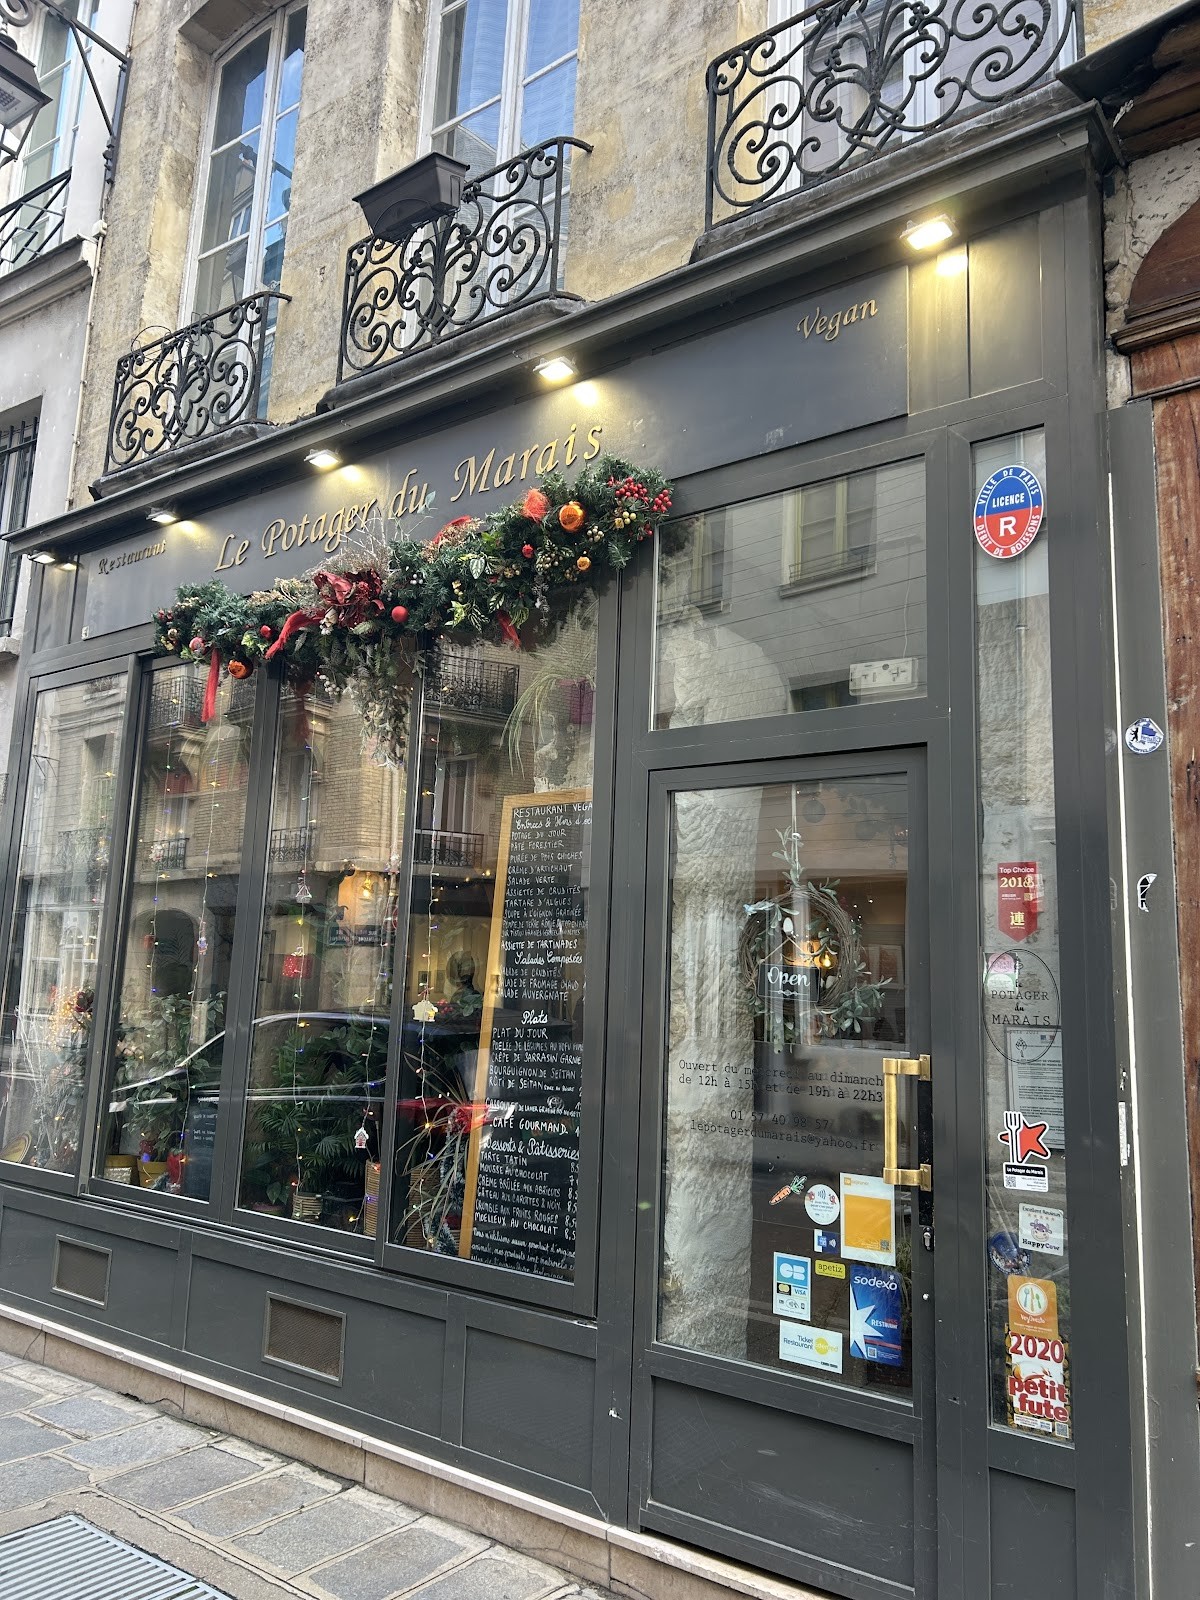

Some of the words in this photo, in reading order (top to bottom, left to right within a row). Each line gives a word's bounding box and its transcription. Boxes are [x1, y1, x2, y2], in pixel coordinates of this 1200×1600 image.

[797, 299, 879, 341] Vegan
[978, 477, 998, 506] VILLE
[1002, 468, 1014, 478] DE
[1018, 470, 1040, 496] PARIS
[214, 533, 251, 573] Le
[261, 498, 378, 559] Potager
[388, 468, 433, 520] du
[450, 423, 603, 503] Marais
[992, 492, 1025, 509] LICENCE
[999, 515, 1018, 537] R
[976, 523, 993, 548] DEBIT
[993, 546, 1005, 557] DE
[1009, 514, 1041, 555] BOISSONS
[98, 539, 167, 575] Restaurant
[513, 804, 570, 819] RESTAURANT
[572, 801, 592, 812] VEGA
[545, 817, 552, 828] &
[511, 831, 532, 841] POTAGE
[548, 828, 567, 839] JOUR
[528, 840, 565, 850] FORESTIER
[541, 852, 554, 862] POIS
[556, 851, 583, 860] CHICHES
[1000, 866, 1012, 875] Top
[507, 876, 530, 886] SALADE
[535, 876, 555, 884] VERTE
[506, 888, 534, 897] ASSIETTE
[505, 899, 535, 908] TARTARE
[501, 940, 526, 950] ASSIETTE
[527, 941, 535, 949] DE
[537, 939, 578, 949] TARTINADES
[514, 951, 545, 965] Salades
[546, 949, 583, 968] Composées
[521, 968, 528, 976] DE
[767, 965, 811, 987] Open
[519, 978, 527, 988] DE
[530, 978, 558, 990] FROMAGE
[521, 989, 569, 1001] AUVERGNATE
[990, 990, 1050, 1001] POTAGER
[1014, 1001, 1025, 1012] du
[521, 1010, 549, 1025] Plats
[991, 1013, 1052, 1026] MARAIS
[492, 1027, 512, 1038] PLAT
[514, 1027, 525, 1038] DU
[527, 1028, 549, 1039] JOUR
[514, 1041, 521, 1050] DE
[513, 1053, 521, 1063] DE
[524, 1052, 559, 1064] SARRASIN
[489, 1065, 539, 1078] BOURGUIGNON
[540, 1069, 547, 1078] DE
[679, 1059, 718, 1075] Ouvert
[724, 1062, 738, 1075] du
[808, 1072, 822, 1082] au
[830, 1071, 884, 1088] dimanch
[507, 1079, 516, 1089] DE
[679, 1074, 692, 1085] de
[698, 1076, 718, 1088] 12h
[724, 1076, 731, 1089] à
[738, 1078, 756, 1091] 15h
[765, 1082, 779, 1093] et
[786, 1083, 800, 1095] de
[808, 1085, 831, 1098] 19h
[838, 1086, 845, 1099] à
[853, 1088, 883, 1103] 22h3
[492, 1116, 515, 1129] CAFÉ
[519, 1118, 569, 1136] GOURMAND
[730, 1109, 743, 1121] 01
[751, 1111, 764, 1123] 57
[772, 1113, 786, 1125] 40
[793, 1116, 807, 1128] 98
[815, 1117, 829, 1130] 57
[690, 1118, 876, 1151] lepotagerdumarais@yahoo.fr
[518, 1142, 526, 1154] &
[526, 1138, 580, 1161] Pâtisseries
[480, 1151, 501, 1163] TARTE
[504, 1155, 528, 1166] TATIN
[480, 1163, 503, 1175] MOUSSE
[514, 1169, 549, 1181] CHOCOLAT
[1012, 1167, 1025, 1175] Potager
[512, 1206, 532, 1220] FRUITS
[474, 1211, 507, 1227] MOELLEUX
[510, 1220, 519, 1229] AU
[523, 1223, 558, 1236] CHOCOLAT
[818, 1263, 843, 1274] apetiz
[853, 1275, 898, 1292] sodexo
[794, 1288, 807, 1296] VISA
[783, 1337, 814, 1352] Restaurant
[797, 1334, 814, 1346] Ticket
[1009, 1331, 1065, 1364] 2020
[1008, 1376, 1067, 1403] petit
